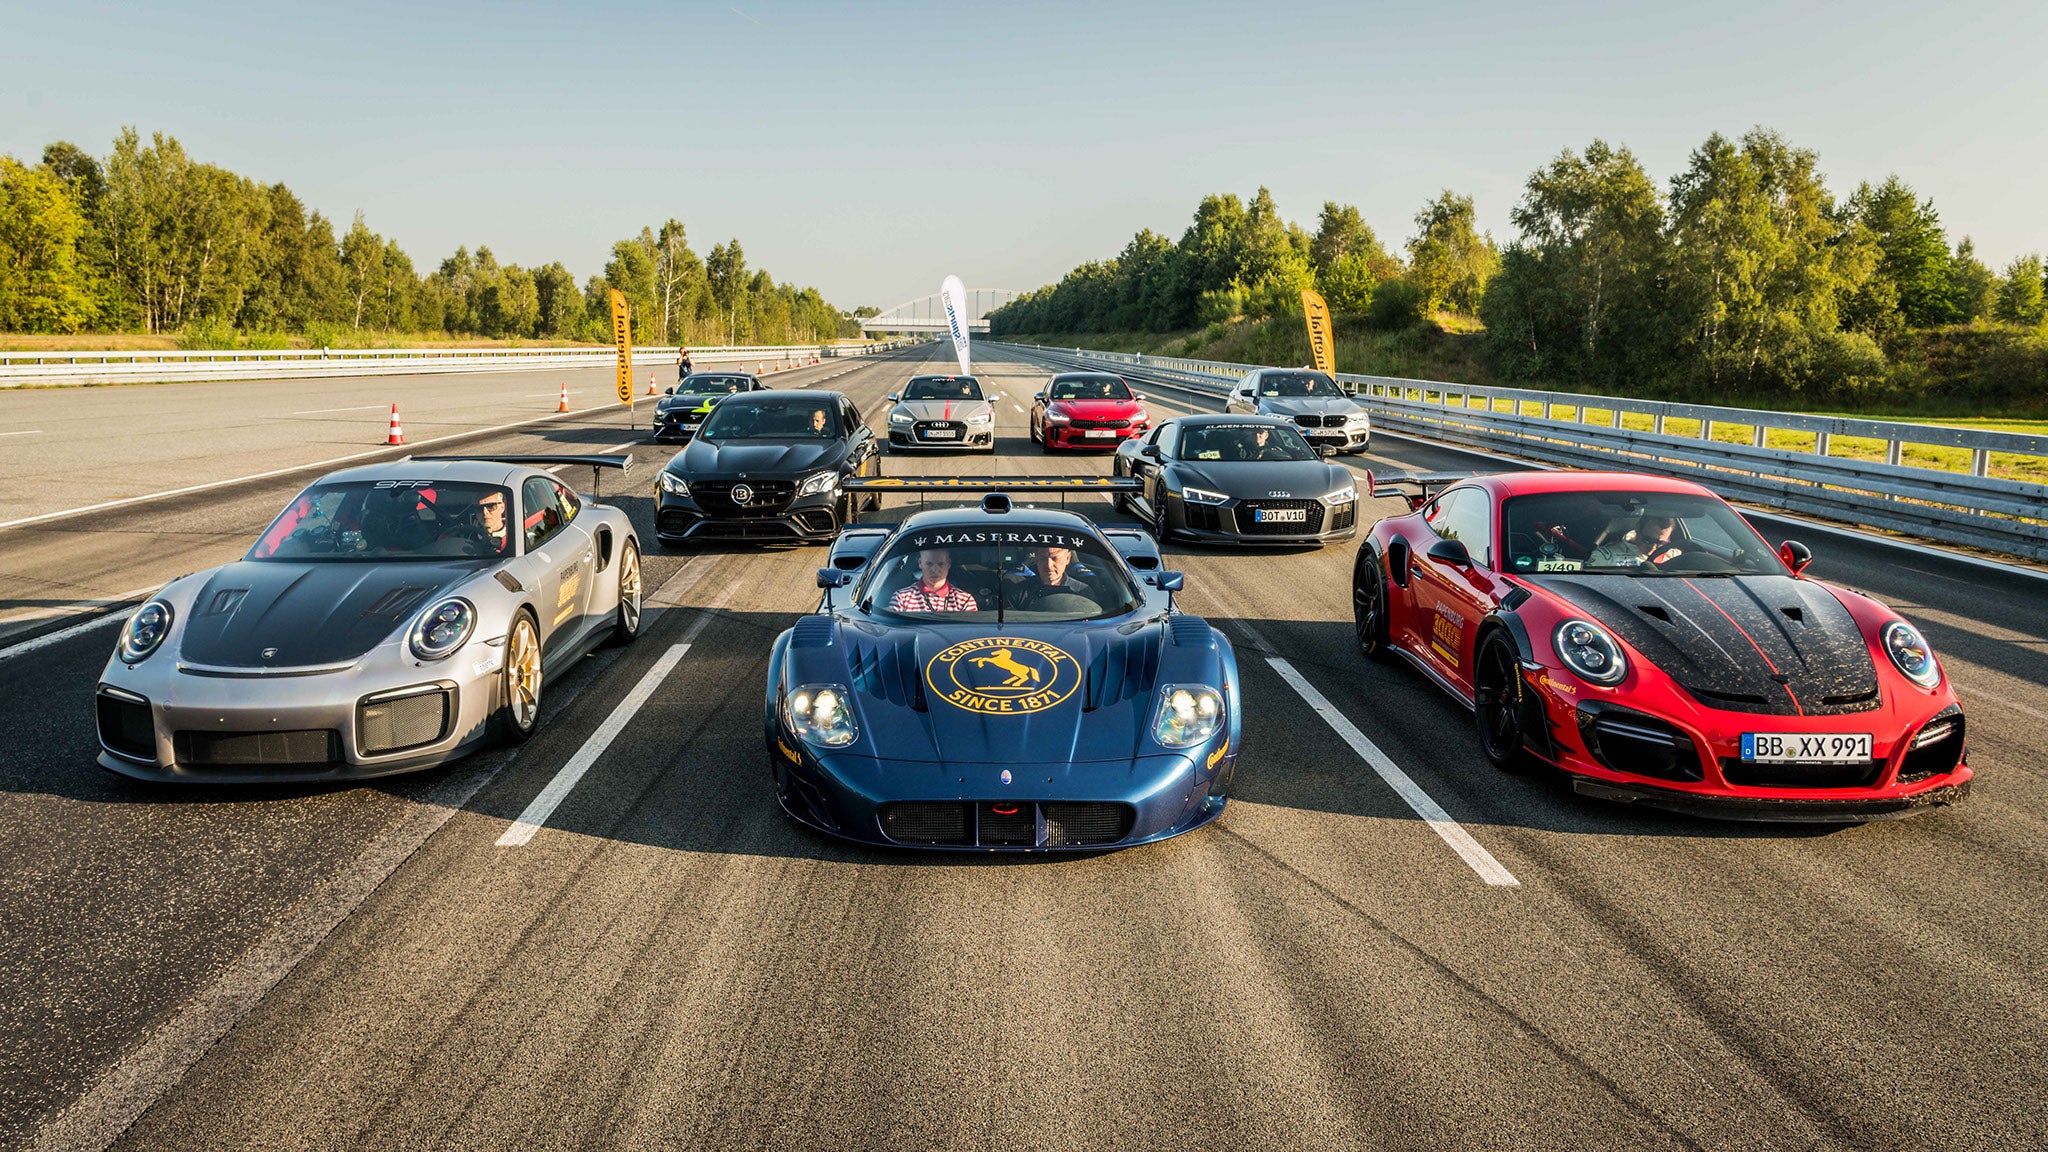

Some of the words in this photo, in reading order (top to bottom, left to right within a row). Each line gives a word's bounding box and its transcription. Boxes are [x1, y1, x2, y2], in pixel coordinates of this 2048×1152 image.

[1261, 511, 1280, 521] BOT
[1286, 511, 1304, 520] V10
[934, 532, 1065, 545] MASERATI
[1544, 563, 1575, 572] 3/40
[1436, 600, 1464, 629] PAPENBURG
[939, 638, 1068, 663] CONTINENTAL
[948, 689, 1013, 712] SINCE
[1018, 689, 1061, 710] 1871
[1756, 737, 1784, 756] BB
[1799, 737, 1826, 757] XX
[1831, 737, 1869, 757] 991
